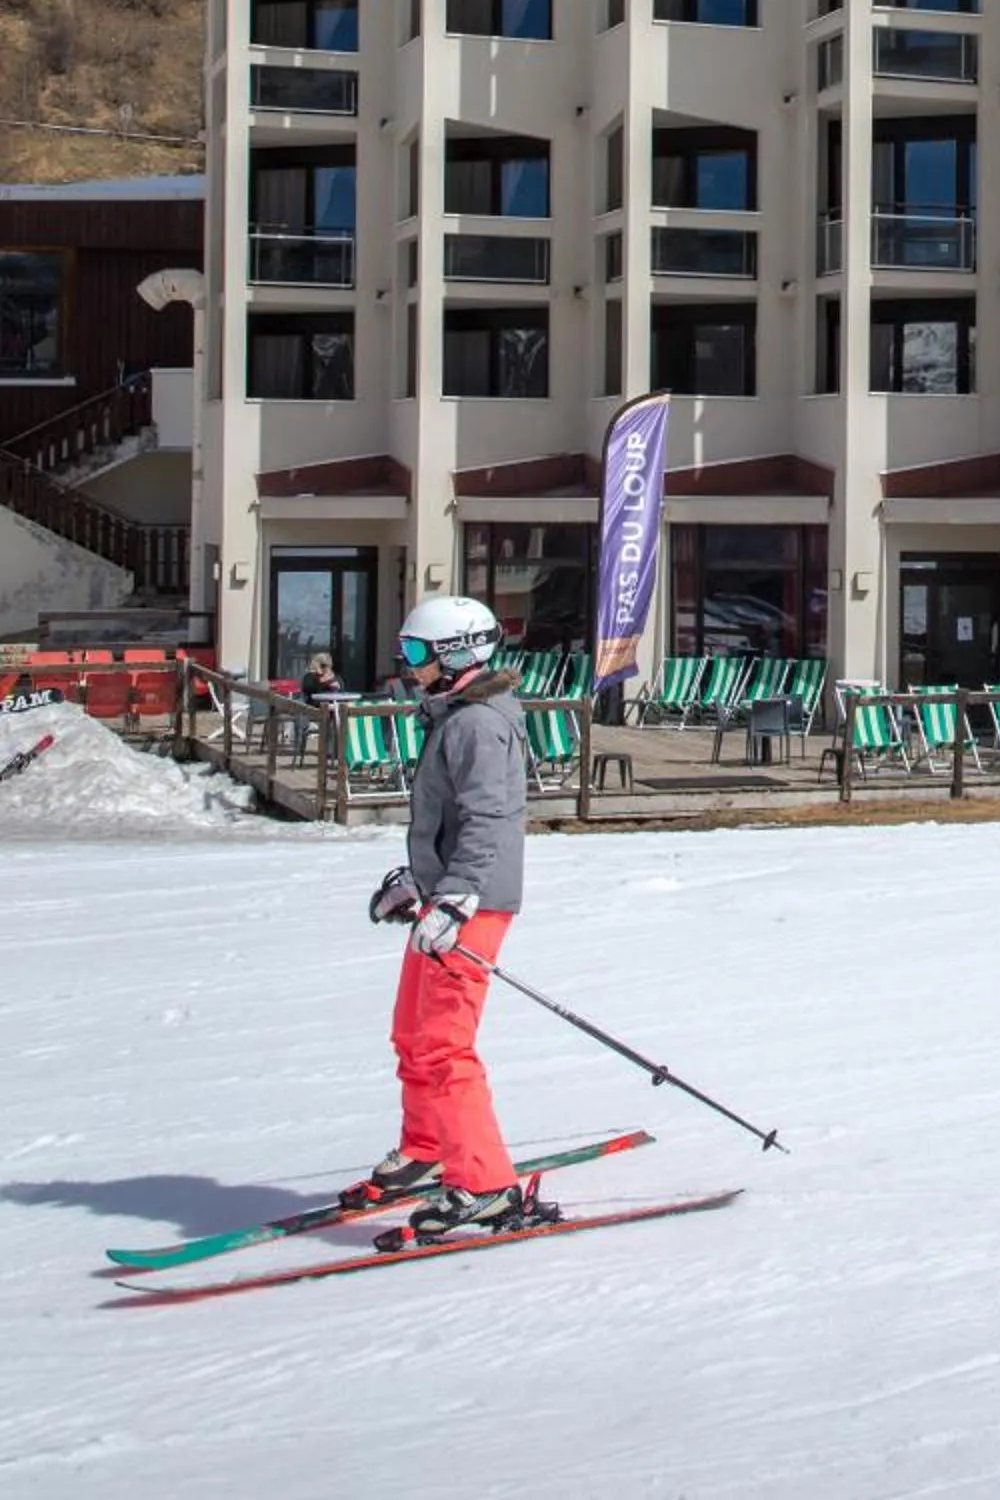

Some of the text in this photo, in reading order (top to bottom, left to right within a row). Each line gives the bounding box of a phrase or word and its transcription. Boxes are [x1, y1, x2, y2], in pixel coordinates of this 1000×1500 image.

[622, 431, 648, 512] LOUP
[620, 521, 645, 562] DU
[615, 571, 639, 624] PAS
